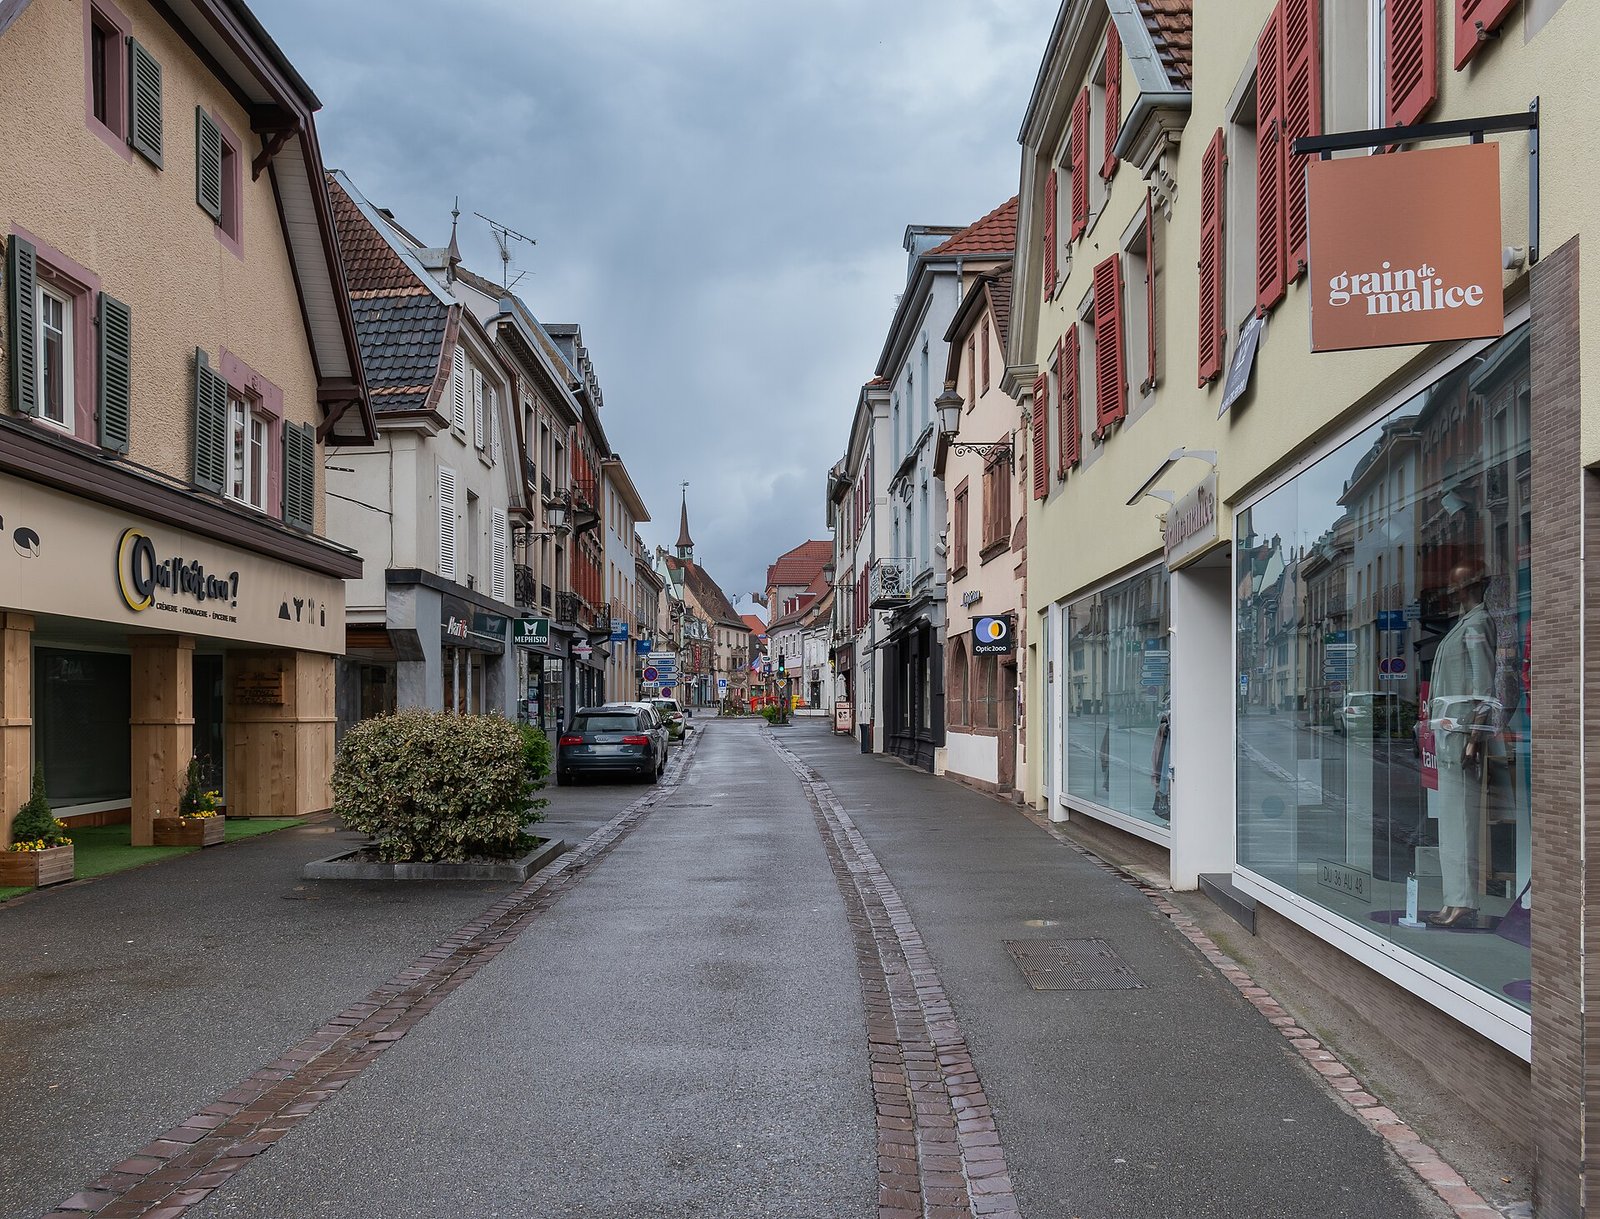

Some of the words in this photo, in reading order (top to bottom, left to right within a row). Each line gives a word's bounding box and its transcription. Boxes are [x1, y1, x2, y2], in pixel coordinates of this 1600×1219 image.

[1329, 261, 1417, 306] grain
[1418, 263, 1435, 278] de
[1366, 278, 1484, 316] malice
[131, 535, 171, 607] Qui
[206, 573, 229, 601] cru
[182, 607, 208, 618] FROMAGERIE
[229, 615, 237, 623] FINE
[514, 636, 547, 644] MEPHISTO
[1323, 866, 1333, 883] DU
[1343, 873, 1353, 890] AU
[1355, 876, 1363, 894] 48
